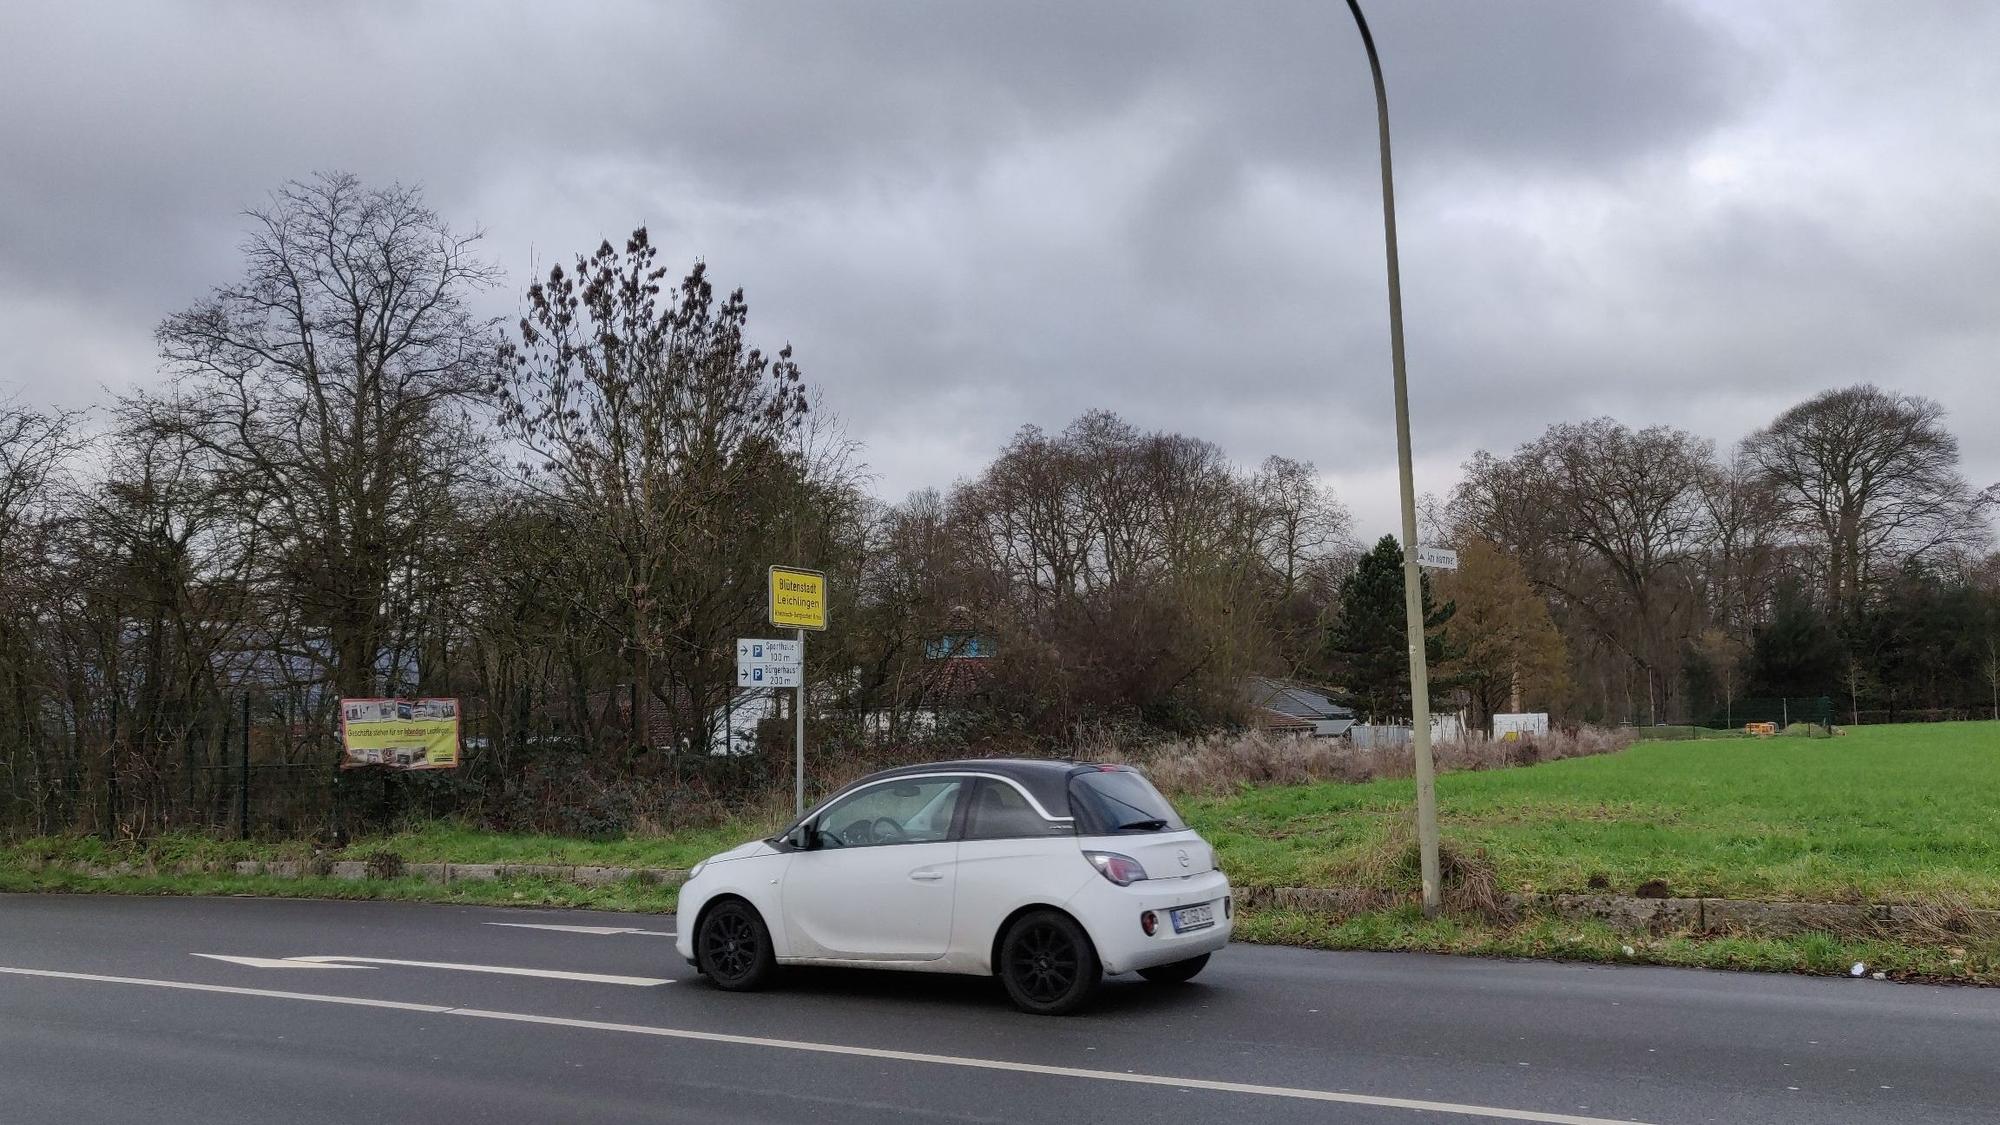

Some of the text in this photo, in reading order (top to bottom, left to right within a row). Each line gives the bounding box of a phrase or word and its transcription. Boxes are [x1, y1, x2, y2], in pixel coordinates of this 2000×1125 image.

[779, 578, 817, 594] Blütenstadt
[777, 594, 820, 610] Leichlingen
[765, 665, 796, 676] Bürgerhaus
[770, 676, 783, 685] 200
